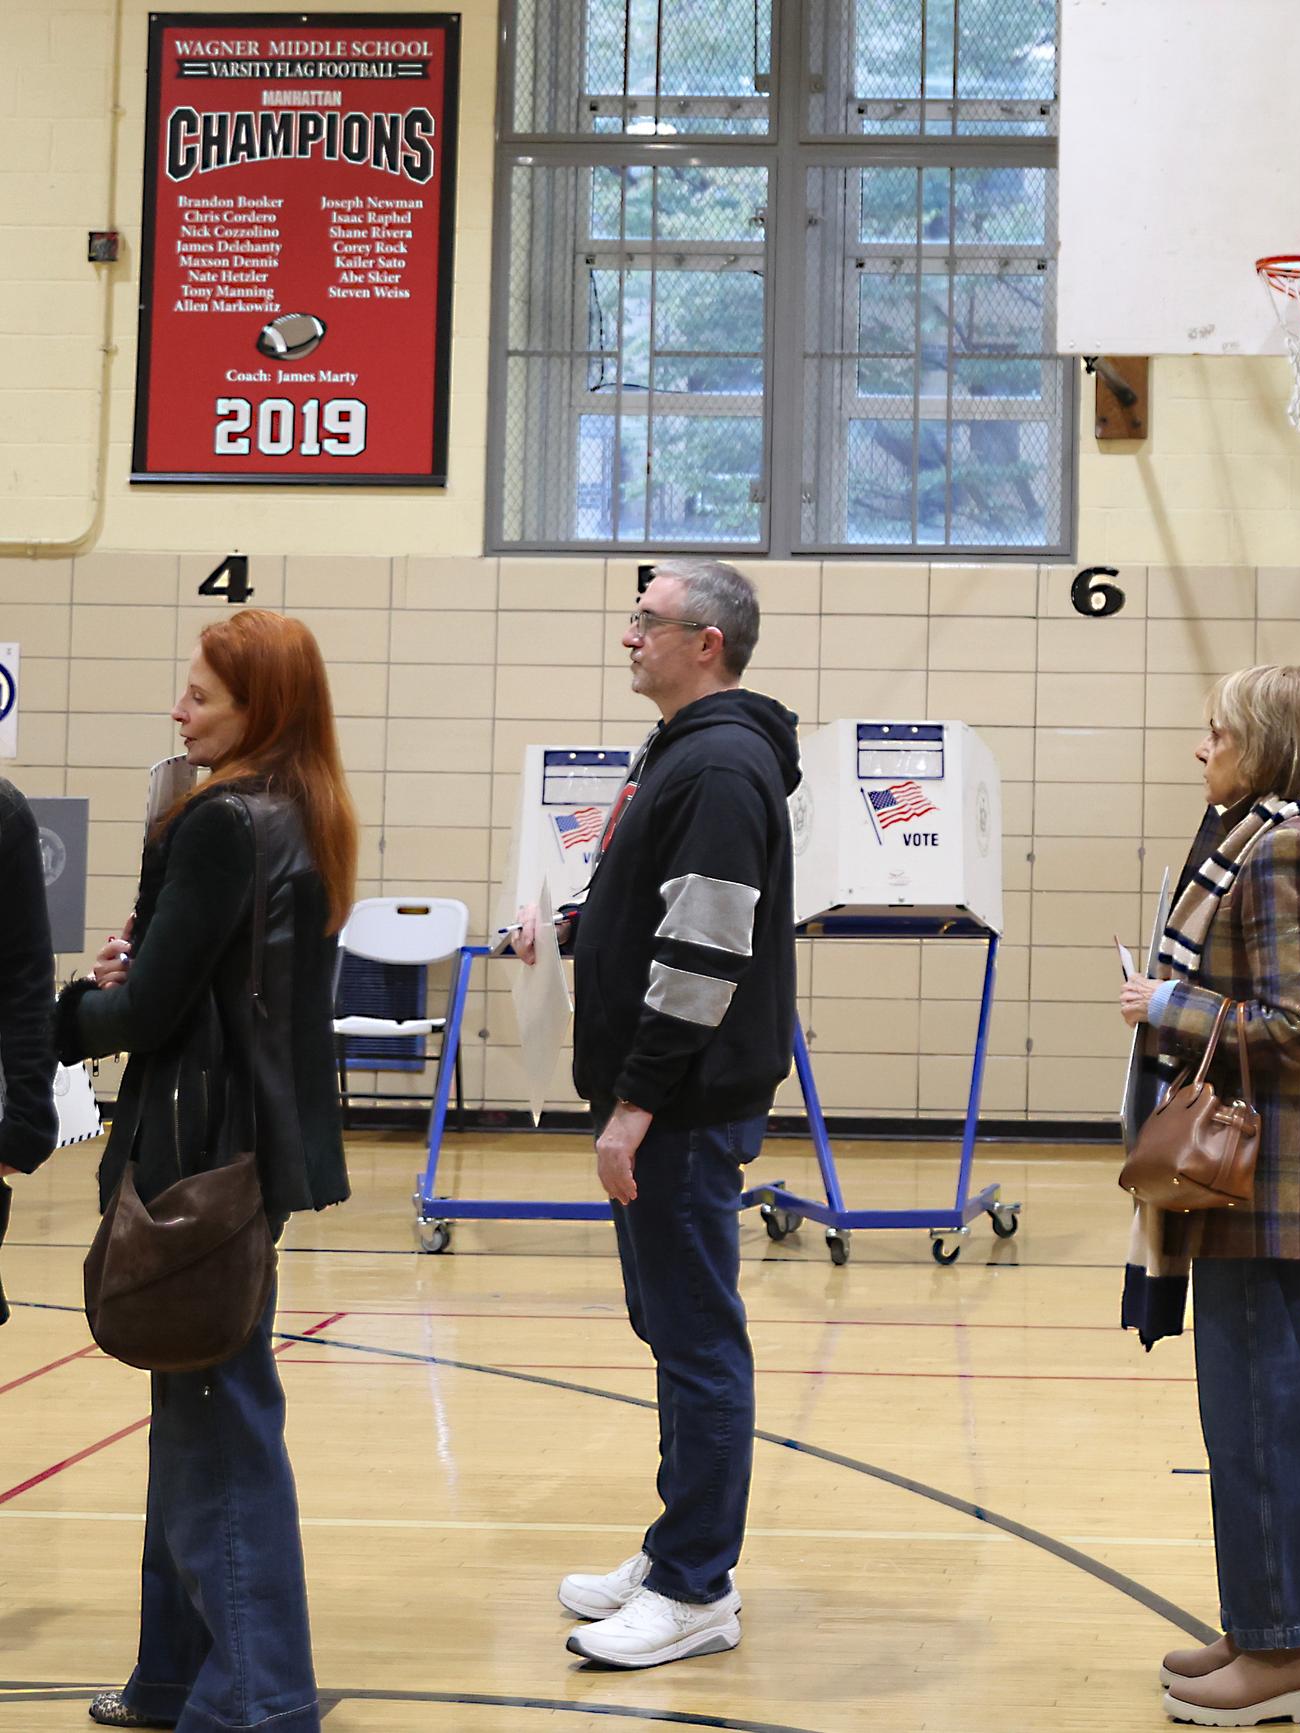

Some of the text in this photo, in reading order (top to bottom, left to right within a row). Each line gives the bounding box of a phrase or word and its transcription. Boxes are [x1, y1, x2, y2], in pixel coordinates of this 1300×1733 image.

[175, 40, 433, 57] WAGNER MIDDLE SCHOOL
[210, 61, 397, 78] VARSITY FLAG FOOTBALL
[262, 90, 341, 106] MANHATTAN
[166, 106, 434, 184] CHAMPIONS
[178, 195, 284, 208] Brandon Booker
[321, 196, 424, 211] Joseph Newman
[184, 210, 277, 223] Chris Cordero
[332, 211, 412, 226] Isaac Raphel
[181, 225, 280, 238] Nick Cozzolino
[330, 226, 413, 238] Shane Rivera
[176, 240, 282, 255] James Delehanty
[333, 241, 408, 256] Corey Rock
[179, 255, 279, 268] Maxson Dennis
[335, 256, 406, 269] Kailer Sato
[188, 269, 269, 283] Nate Hetzler
[340, 271, 402, 283] Abe Skier
[181, 284, 275, 300] Tony Manning
[328, 285, 411, 299] Steven Weiss
[174, 299, 281, 313] Allen Markowitz
[226, 369, 359, 386] Coach: James Marty
[214, 398, 367, 456] 2019
[198, 554, 254, 604] 4
[1070, 567, 1127, 617] 6
[903, 833, 939, 846] VOTE
